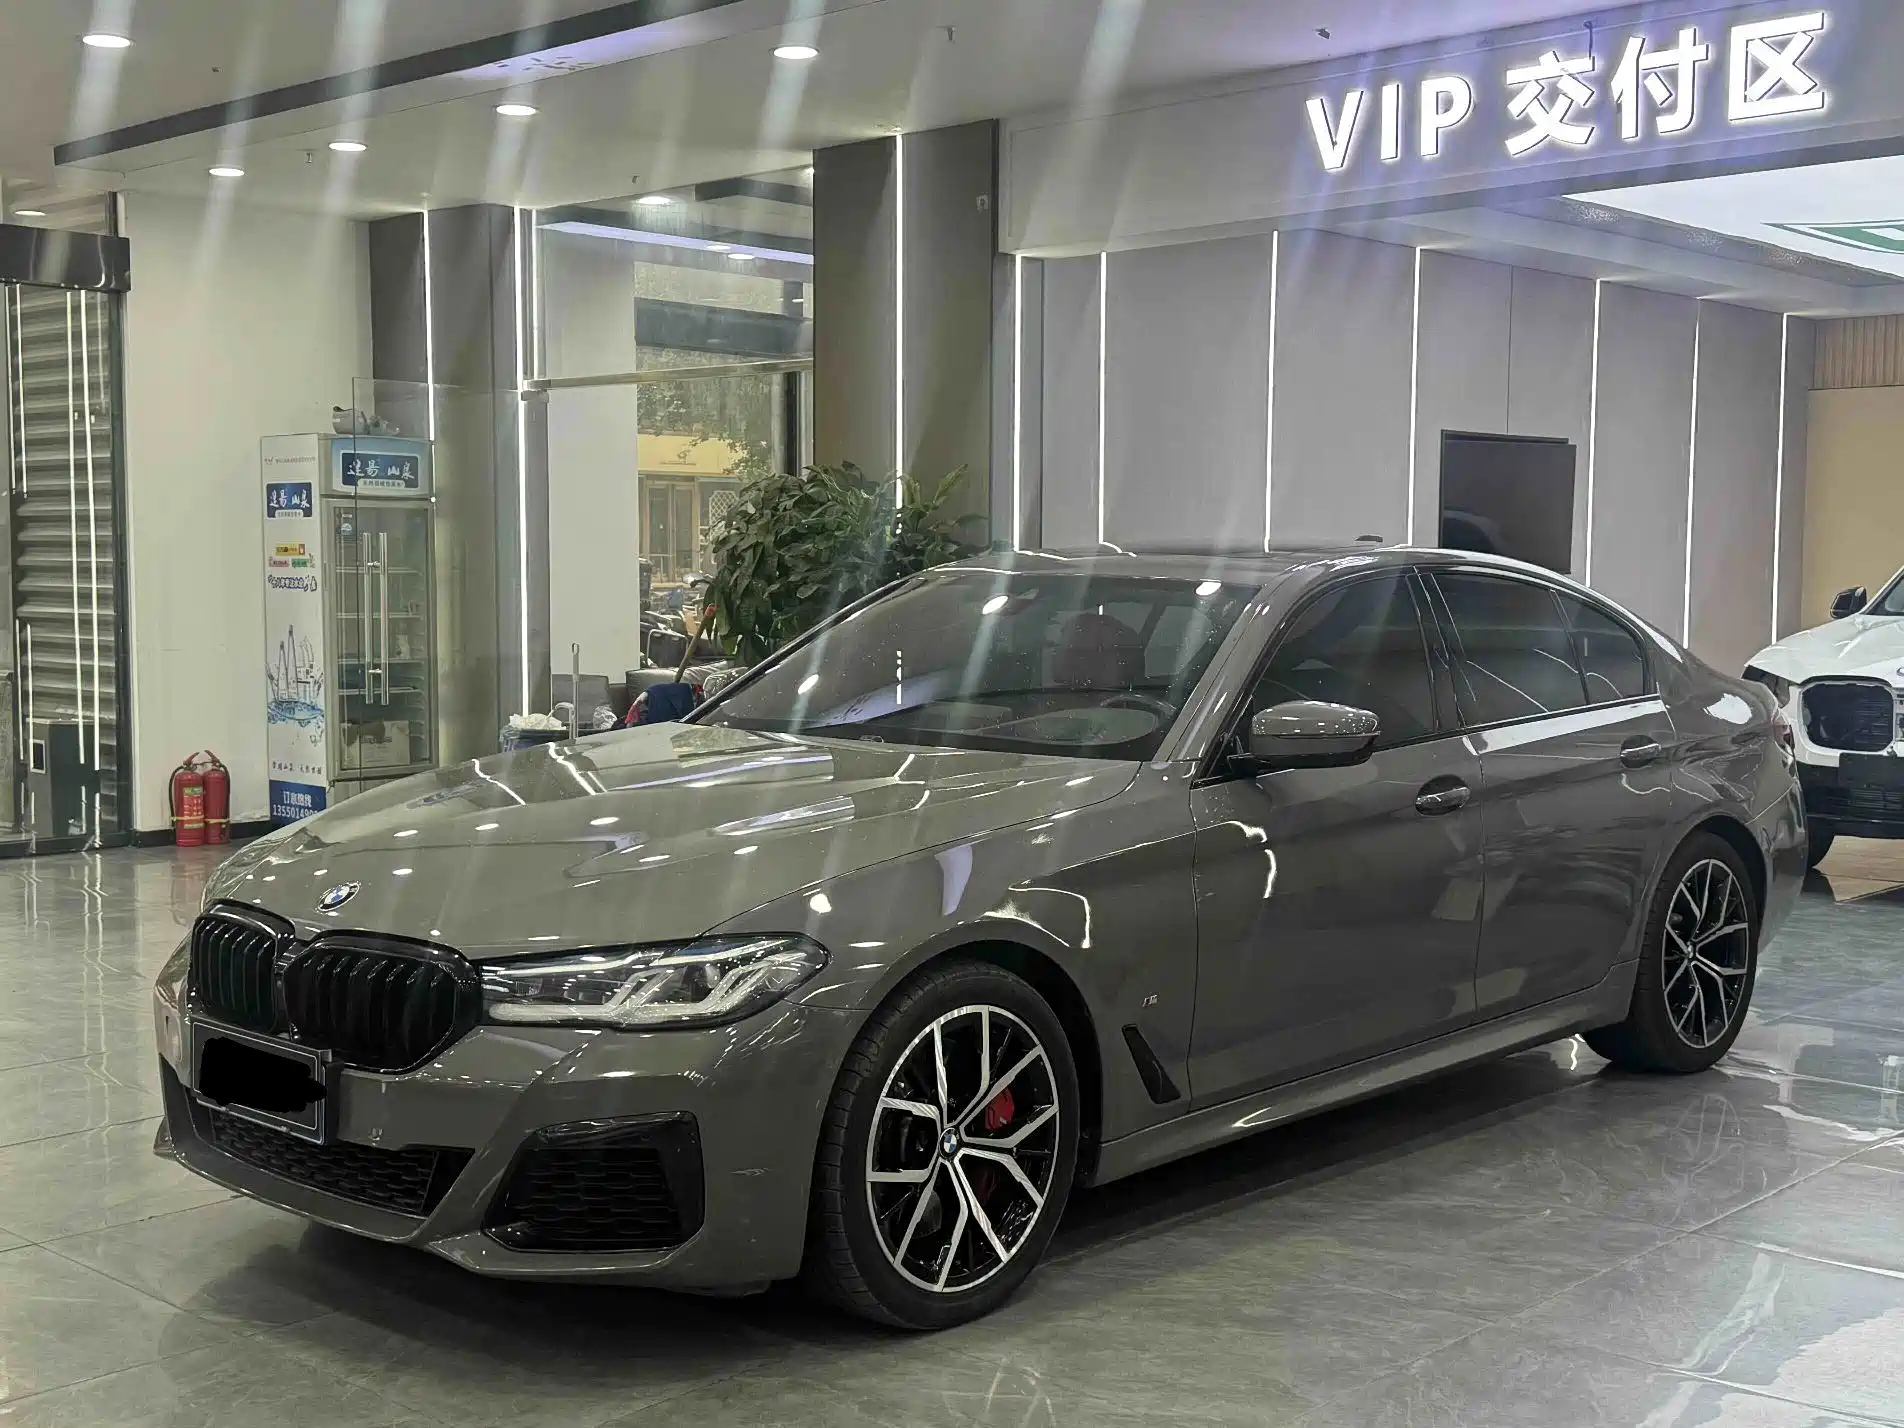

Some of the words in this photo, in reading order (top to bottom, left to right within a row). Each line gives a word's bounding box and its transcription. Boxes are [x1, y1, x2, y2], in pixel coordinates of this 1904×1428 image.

[1306, 75, 1475, 172] VIP
[1503, 11, 1826, 157] 交付区
